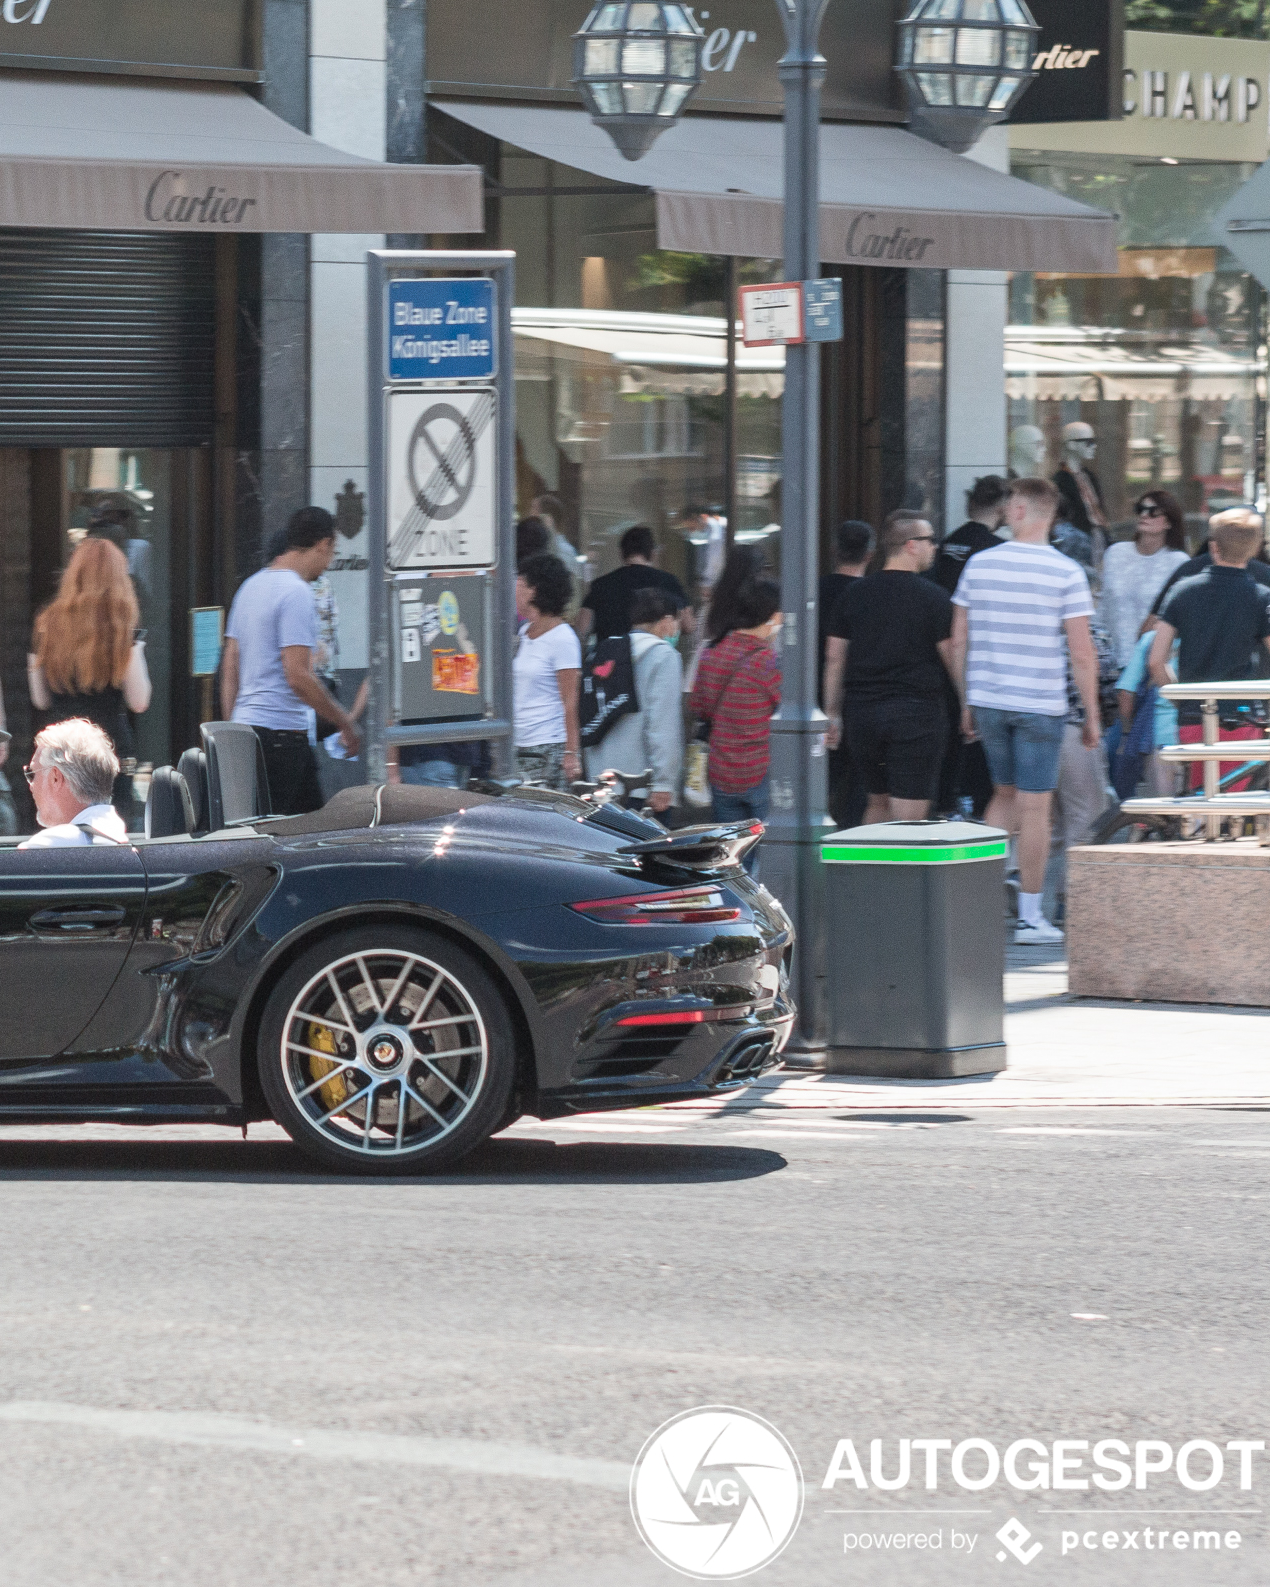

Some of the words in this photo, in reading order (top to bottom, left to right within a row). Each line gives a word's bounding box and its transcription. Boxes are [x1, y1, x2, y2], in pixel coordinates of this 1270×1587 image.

[1031, 44, 1100, 70] rtier
[144, 170, 257, 223] Cartier
[845, 211, 935, 261] Cartier
[393, 302, 443, 325] Blaue
[445, 301, 488, 325] Zone
[392, 333, 489, 364] Königsallee
[415, 529, 468, 557] ZONE
